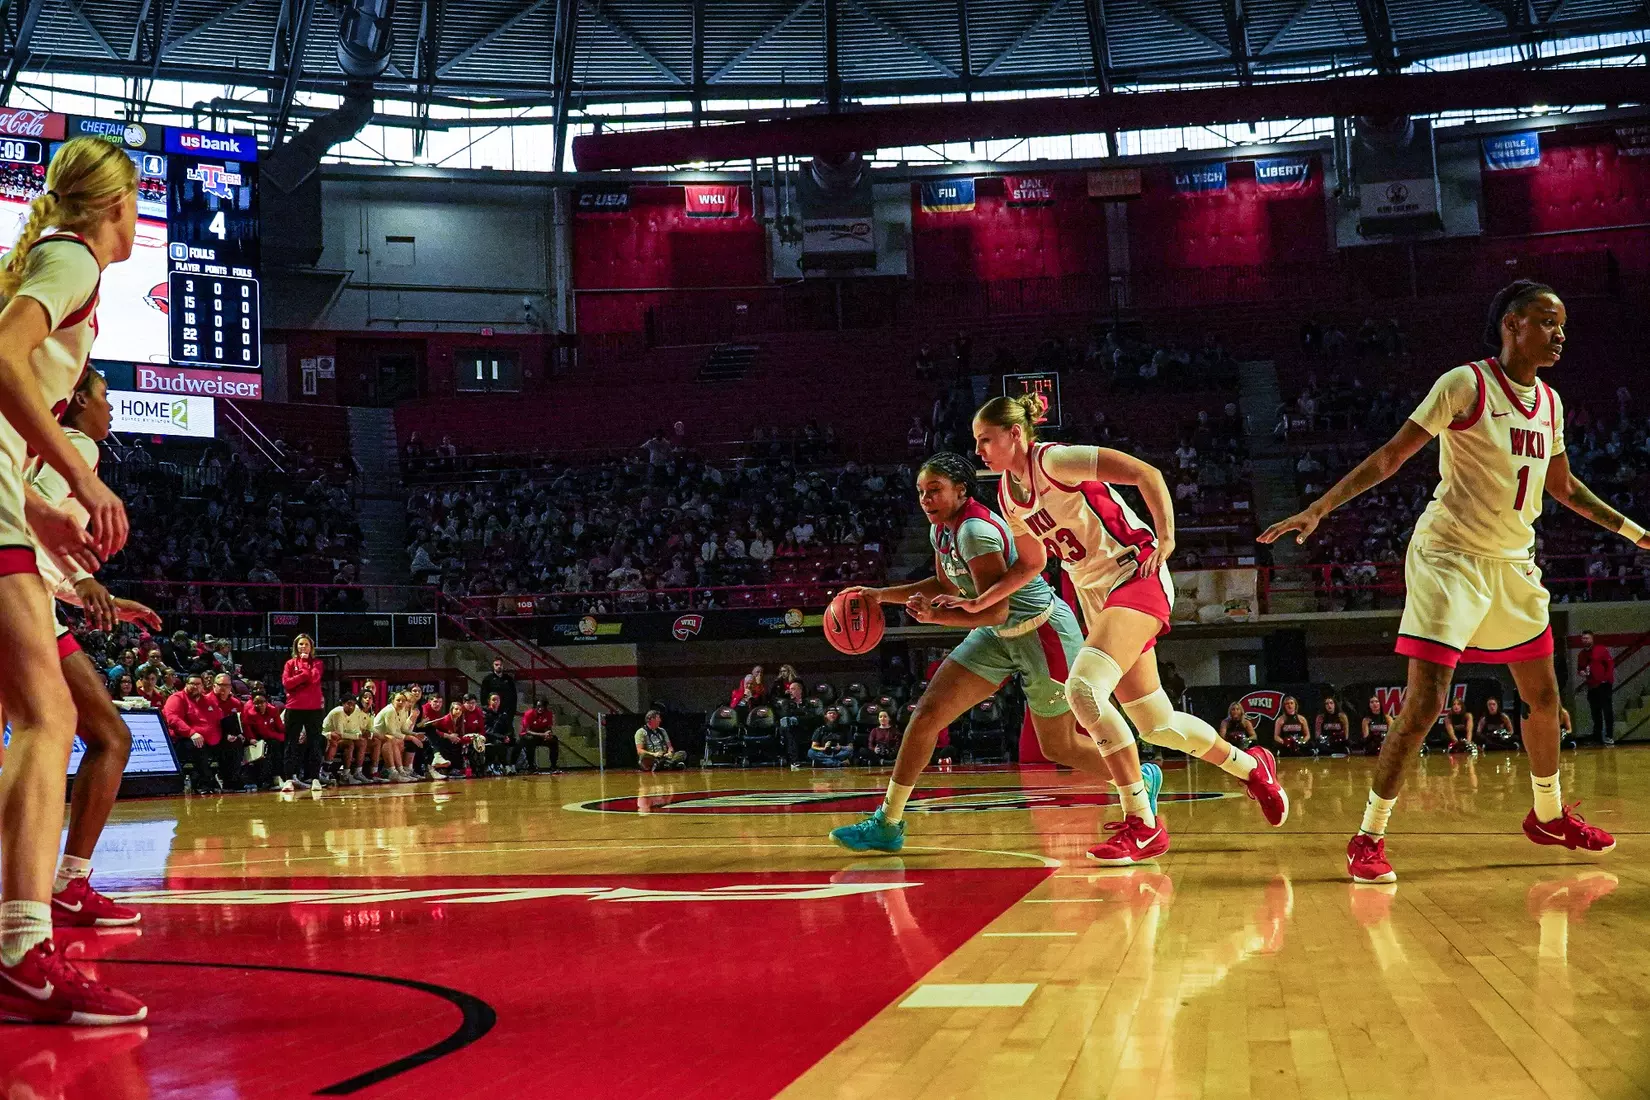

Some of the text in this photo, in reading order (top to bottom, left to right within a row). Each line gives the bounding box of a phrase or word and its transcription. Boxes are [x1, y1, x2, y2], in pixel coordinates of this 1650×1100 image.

[80, 120, 124, 135] CHEETAH
[148, 158, 159, 173] 4
[1259, 164, 1308, 178] LIBERTY
[594, 194, 628, 206] USA
[699, 194, 725, 204] WKU
[938, 188, 957, 198] FIU
[1013, 188, 1050, 199] STATE
[208, 211, 226, 240] 4
[175, 246, 216, 260] 0 FOULS
[175, 262, 253, 278] PLAYER POINTS FOULS
[185, 280, 249, 298] 3 0 0
[184, 295, 249, 314] 15 0 0
[184, 312, 250, 330] 18 0 0
[183, 327, 250, 345] 22 0 0
[183, 344, 251, 361] 23 0 0
[139, 369, 259, 397] Budweiser
[121, 399, 170, 418] HOME
[1510, 426, 1545, 460] WKU
[1513, 465, 1530, 510] 1
[407, 615, 432, 625] GUEST
[1248, 697, 1273, 710] WKU
